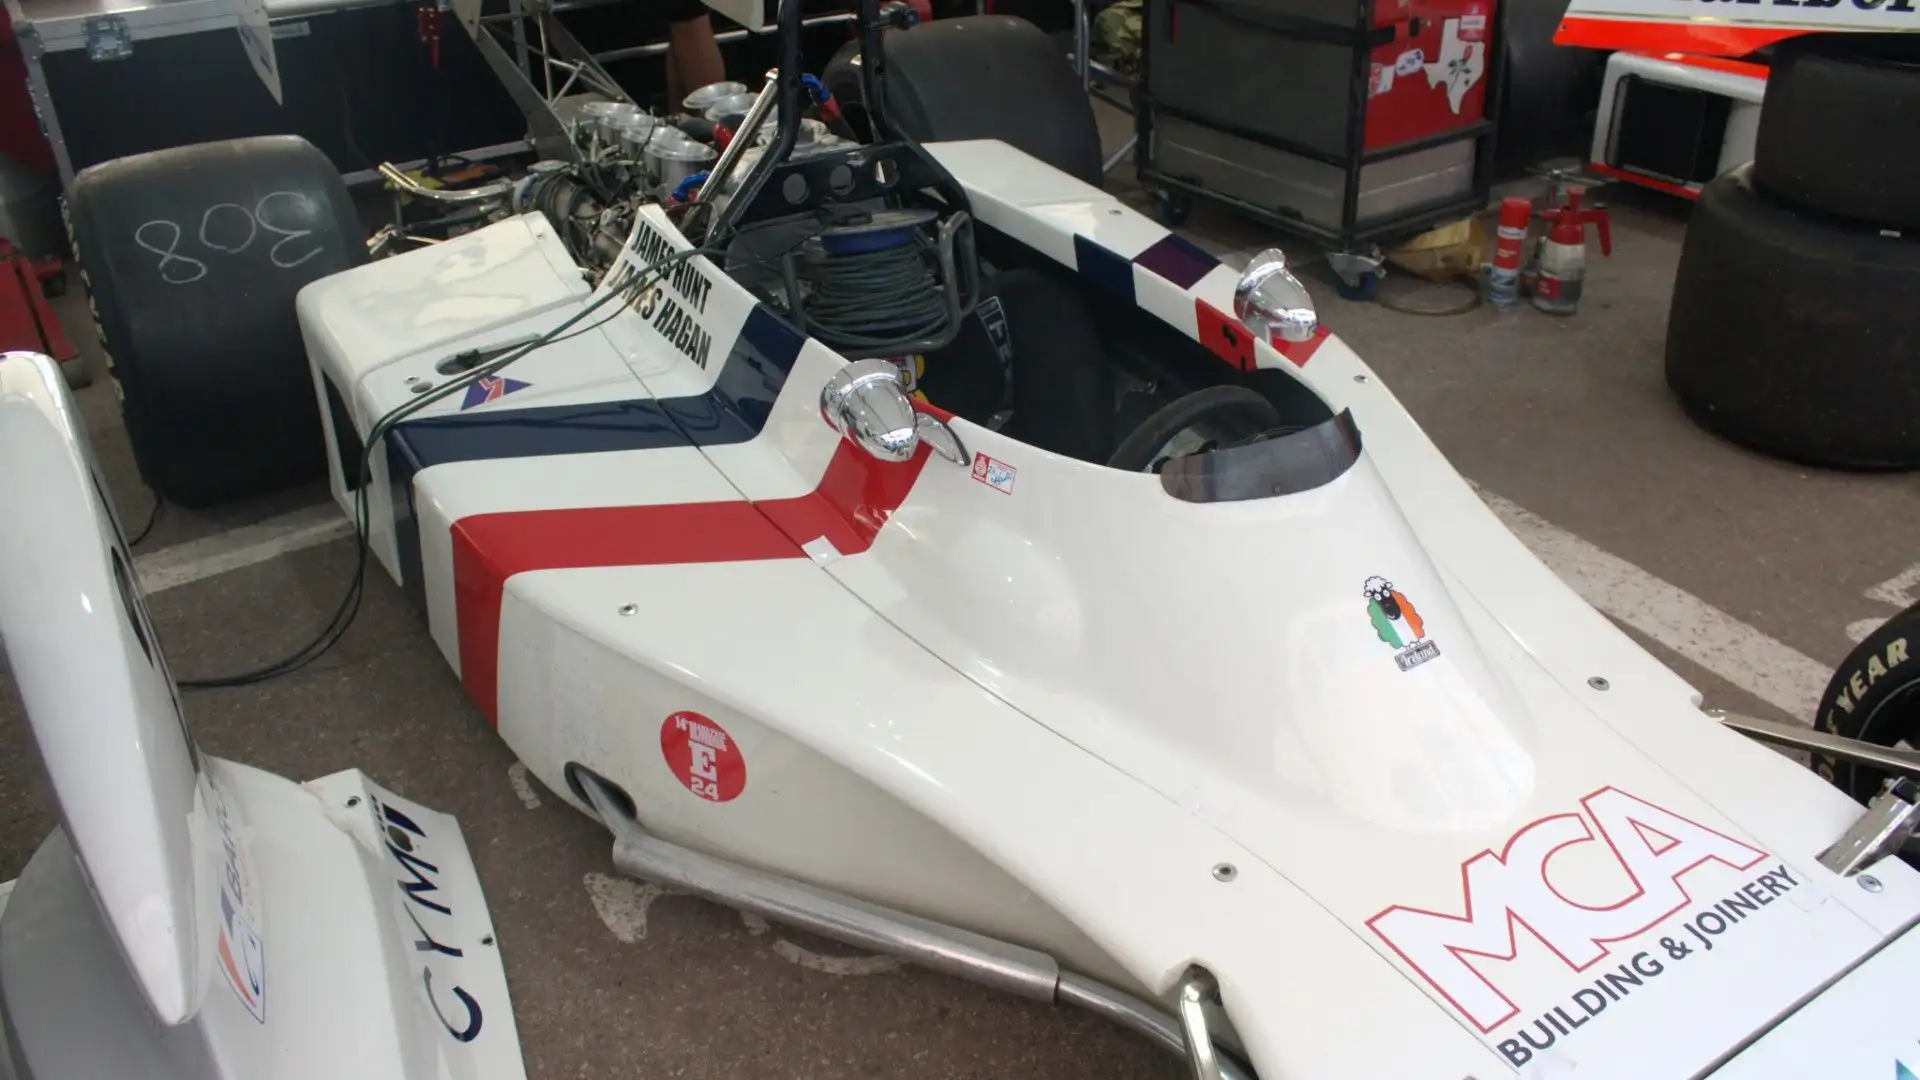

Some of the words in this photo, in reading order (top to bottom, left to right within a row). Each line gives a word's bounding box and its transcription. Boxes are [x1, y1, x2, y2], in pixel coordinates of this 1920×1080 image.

[608, 259, 663, 320] JAMES
[653, 297, 712, 371] HAGAN
[631, 221, 676, 281] JAMES
[672, 257, 712, 315] HUNT
[1400, 643, 1436, 667] Ireland
[688, 739, 718, 783] E
[690, 776, 719, 801] 24
[1364, 785, 1770, 1035] MCA
[1496, 951, 1665, 1068] BUILDING
[1659, 936, 1693, 961] &
[1683, 864, 1799, 951] JOINERY
